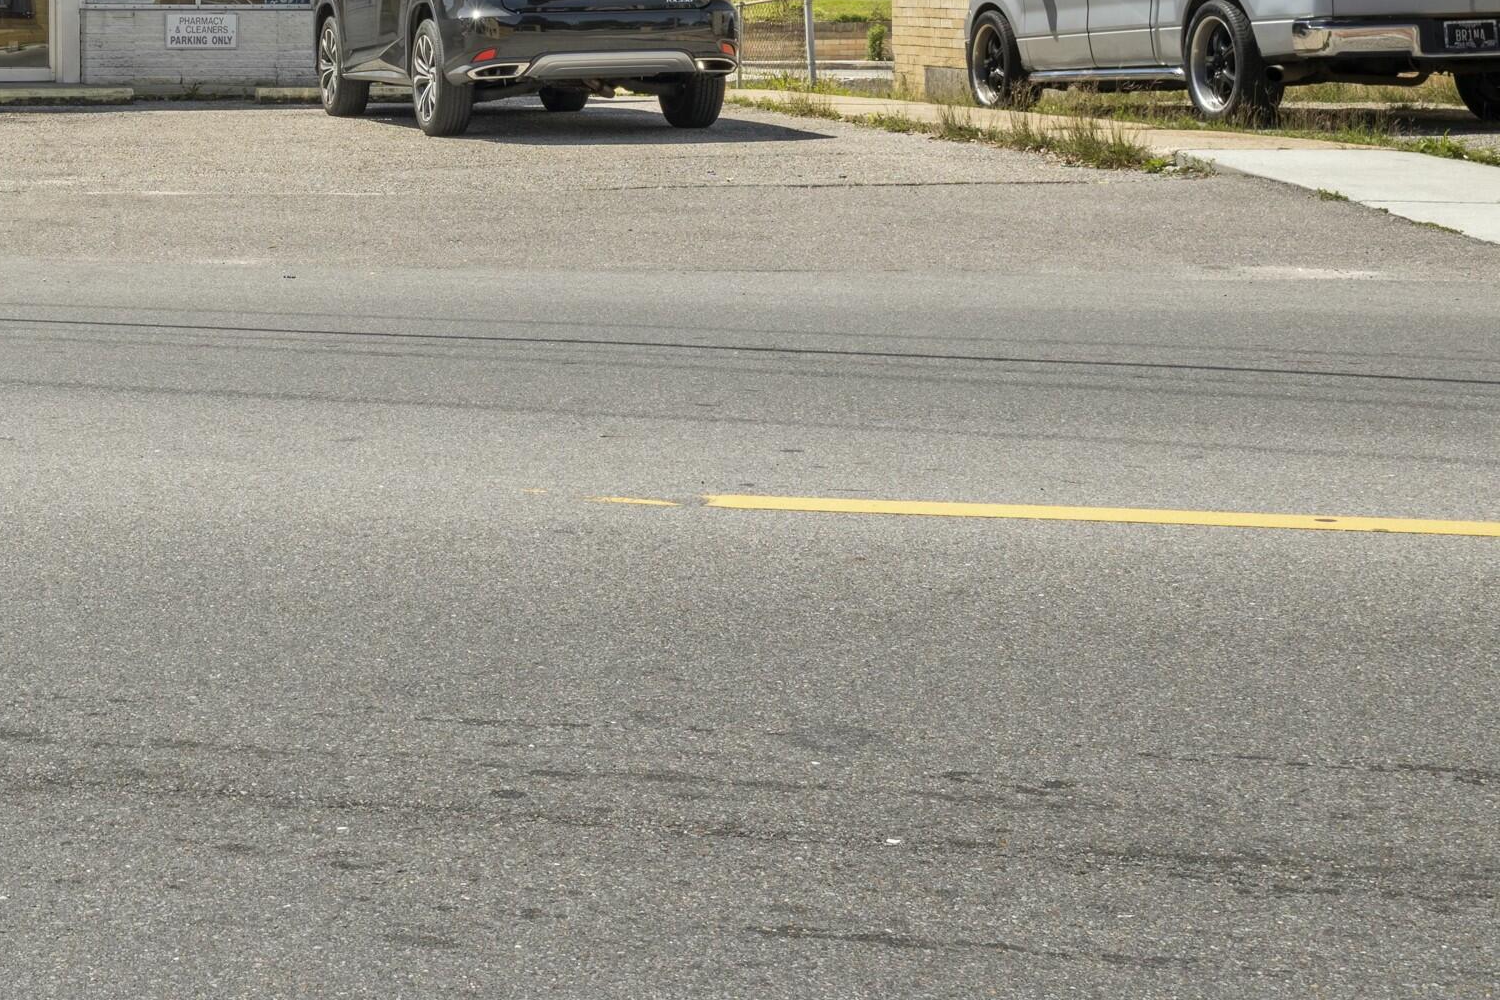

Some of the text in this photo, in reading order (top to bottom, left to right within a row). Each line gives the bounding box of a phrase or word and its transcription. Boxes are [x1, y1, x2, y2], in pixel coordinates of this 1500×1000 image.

[179, 16, 224, 25] PHARMACY
[186, 26, 228, 34] CLEANERS
[170, 36, 232, 45] PARKING ONLY
